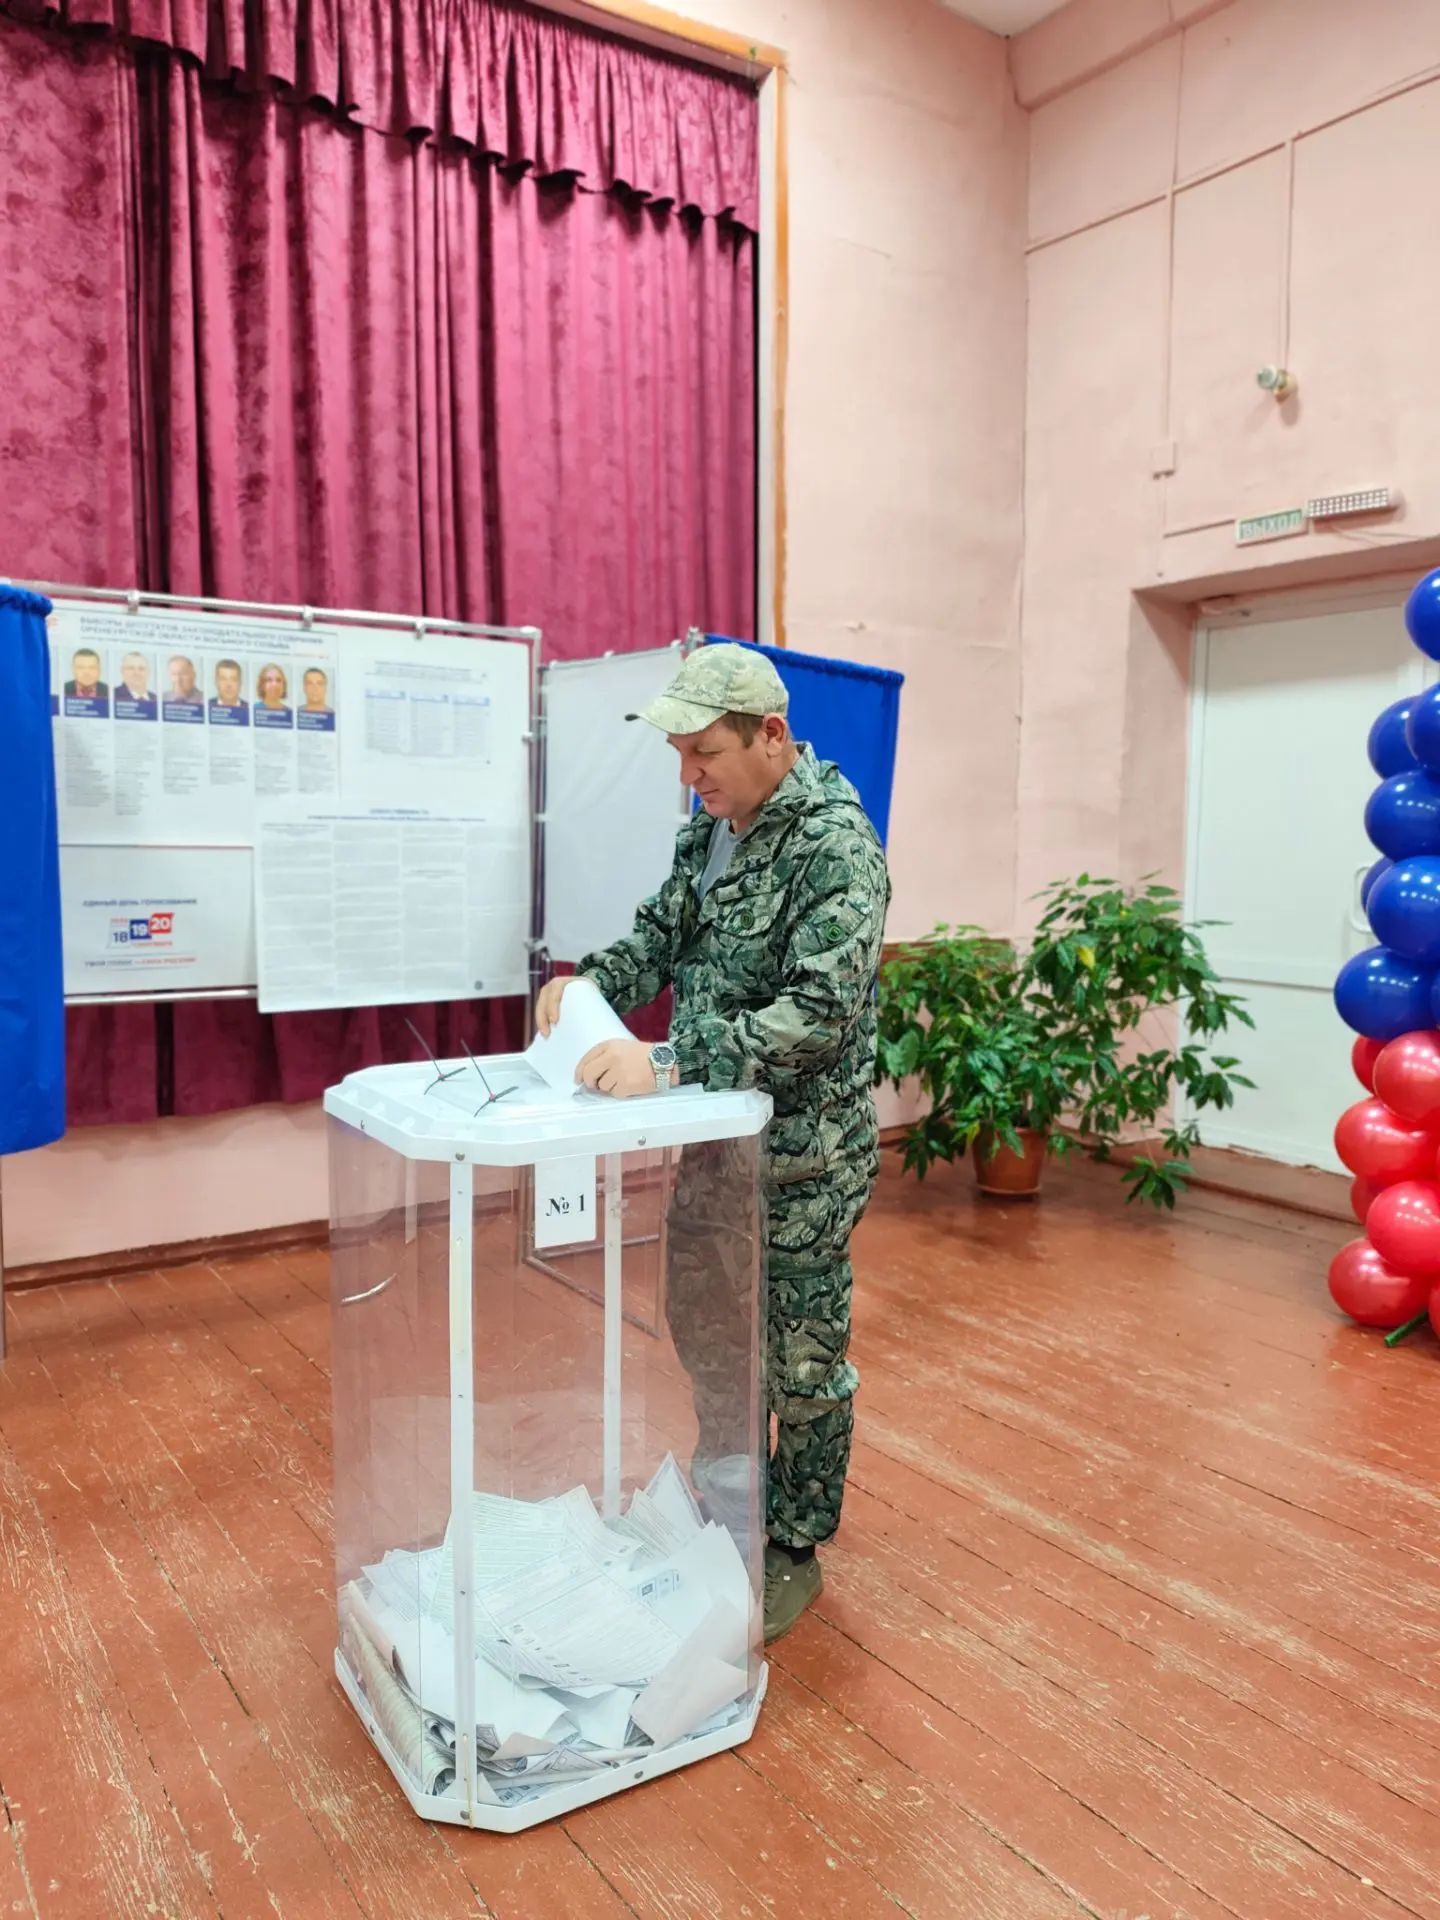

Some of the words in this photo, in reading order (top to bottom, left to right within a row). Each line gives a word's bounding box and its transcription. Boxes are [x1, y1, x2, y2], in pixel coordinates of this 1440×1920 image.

[113, 931, 129, 943] 18
[132, 924, 148, 937] 19
[151, 917, 170, 930] 20
[545, 1197, 569, 1216] №
[578, 1194, 585, 1211] 1
